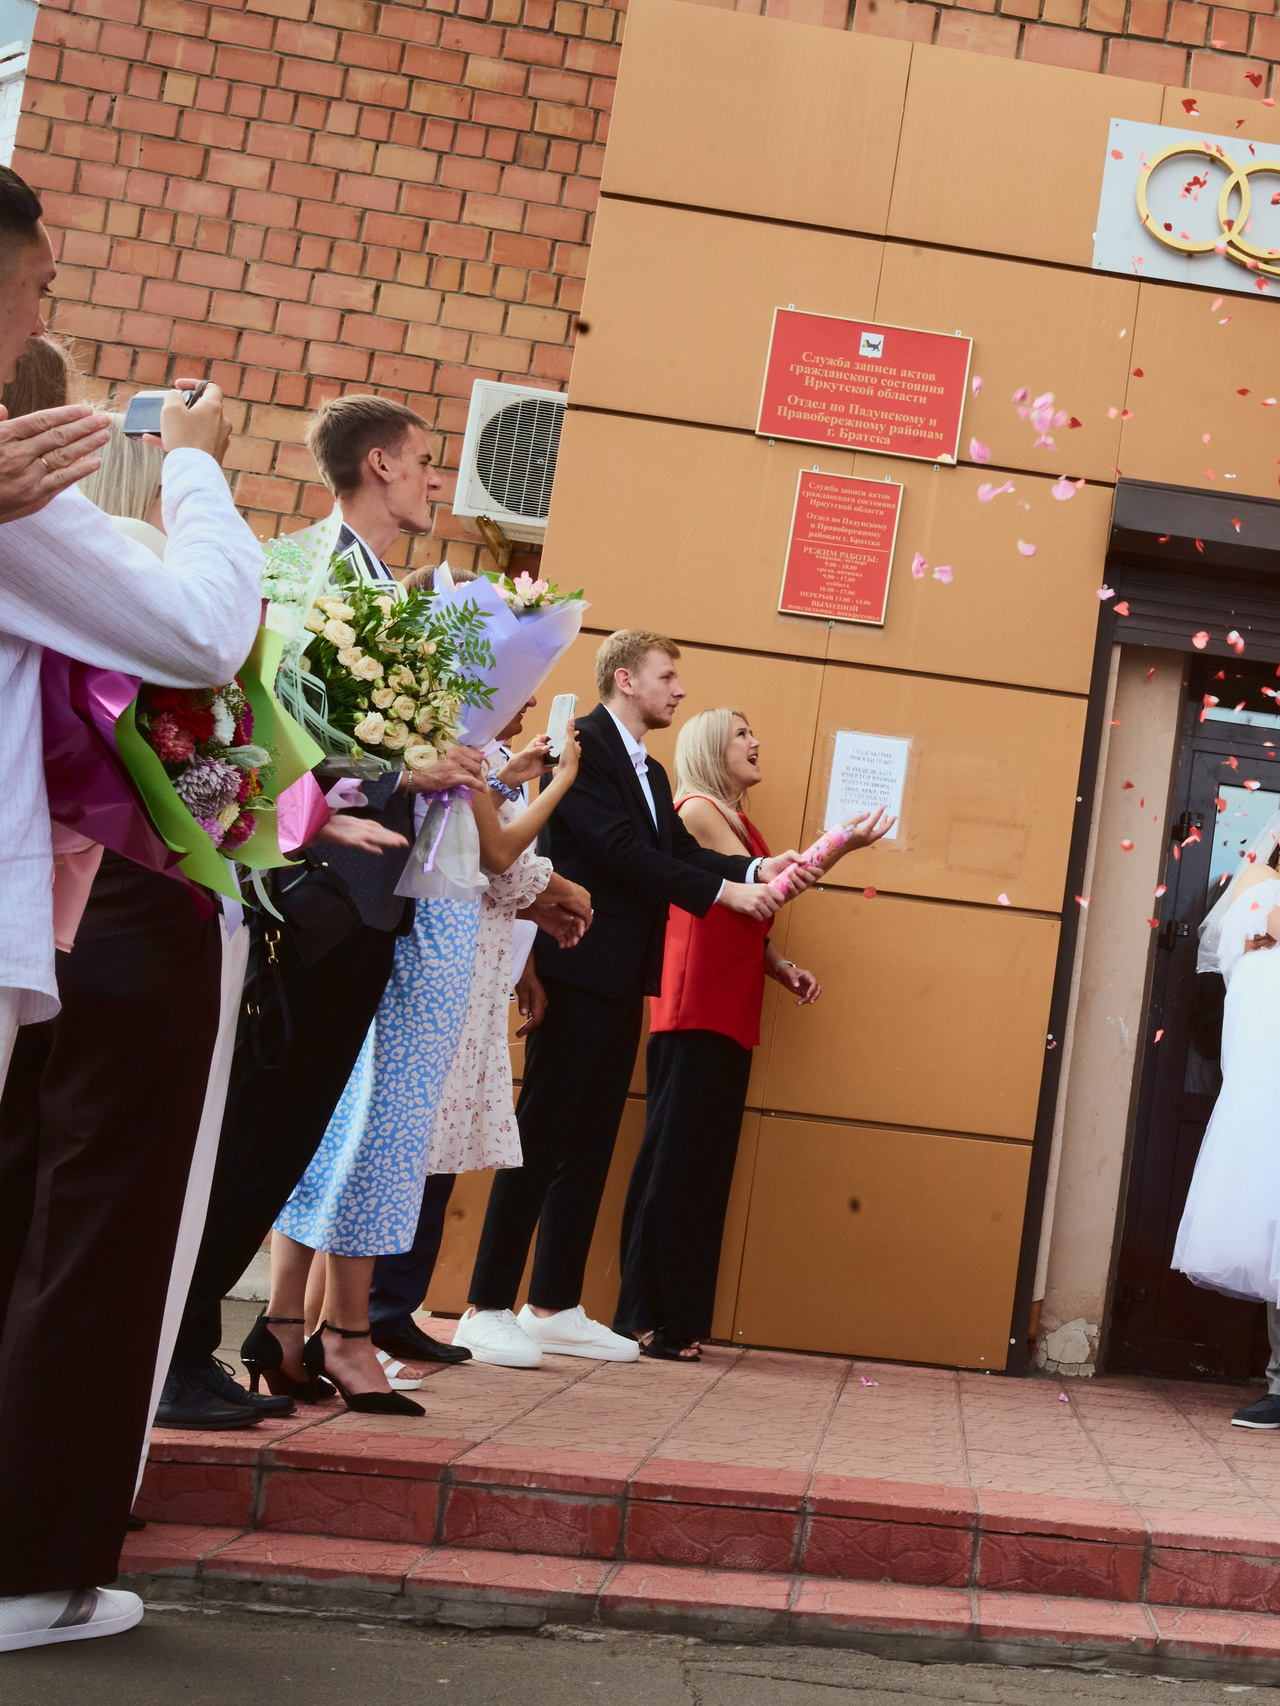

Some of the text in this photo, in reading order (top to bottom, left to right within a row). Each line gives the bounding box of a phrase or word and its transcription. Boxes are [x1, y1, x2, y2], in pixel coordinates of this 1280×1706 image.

[801, 351, 936, 382] Служба записи актов
[789, 363, 945, 395] гражданского состояния
[804, 375, 927, 405] Иркутской области
[787, 394, 937, 428] Отдел по Падунскому и
[777, 405, 944, 441] Правобережному районам
[827, 427, 891, 446] г. Братска
[802, 489, 896, 509] гражданского состояния
[808, 481, 891, 500] Служба записи актов
[809, 498, 885, 516] Иркутской области
[806, 511, 830, 522] Отдел
[842, 517, 888, 532] Падунскому
[817, 522, 881, 539] Правобережному
[808, 530, 841, 541] районам
[849, 536, 881, 547] Братска
[803, 546, 879, 563] РЕЖИМ РАБОТЫ:
[799, 591, 834, 601] ПЕРЕРЫВ
[811, 600, 859, 612] ВЫХОДНОЙ
